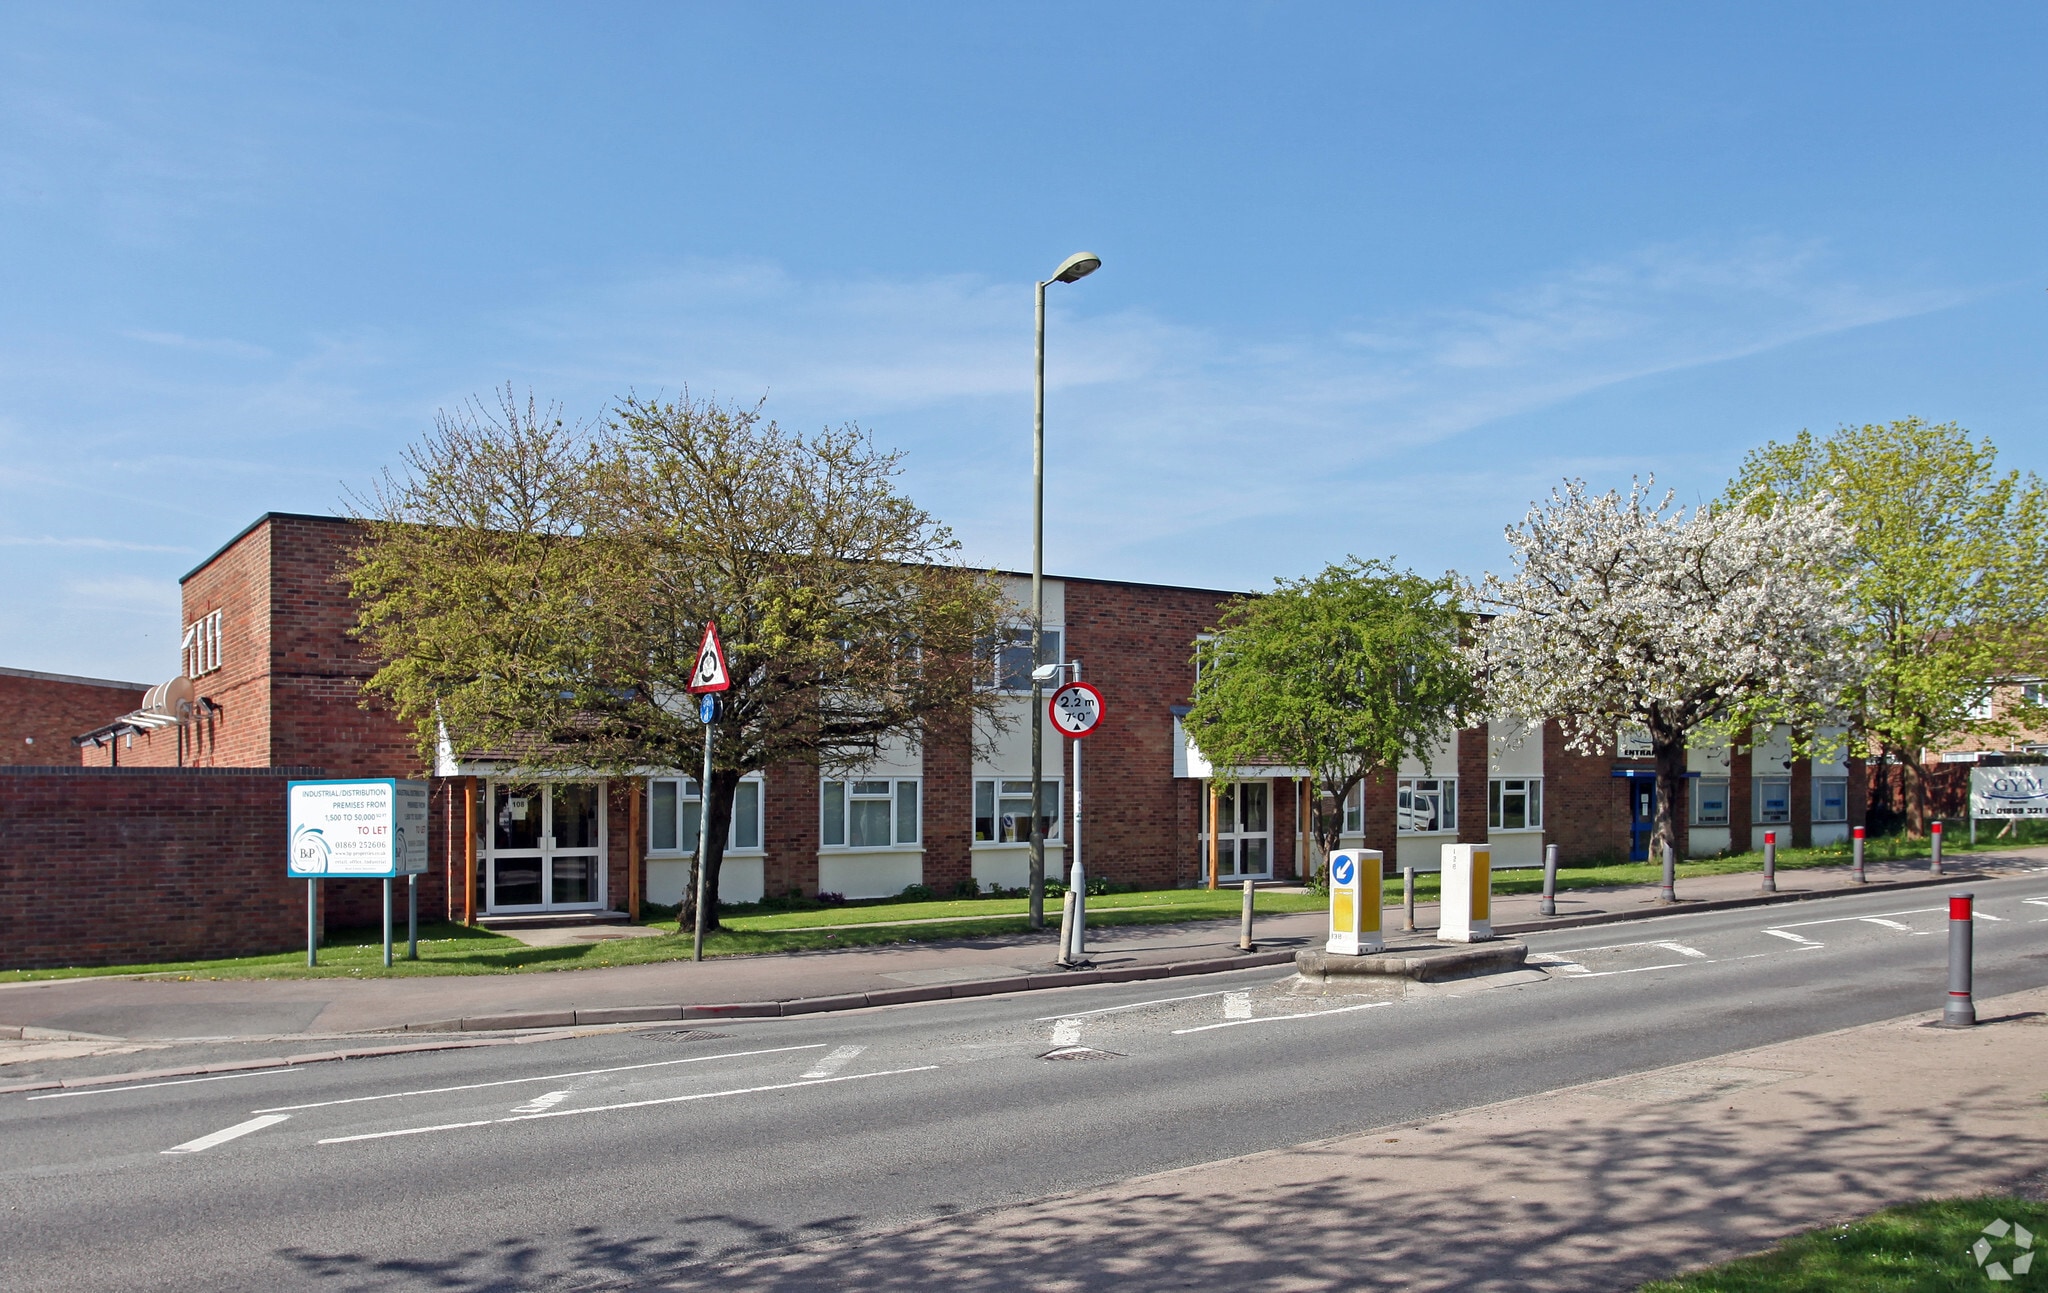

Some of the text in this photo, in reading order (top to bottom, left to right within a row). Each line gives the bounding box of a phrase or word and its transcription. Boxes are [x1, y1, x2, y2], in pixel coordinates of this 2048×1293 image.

[1060, 696, 1095, 708] 2.2 m
[1994, 778, 2044, 792] GYM
[302, 788, 387, 798] INDUSTRIAL/DISTRIBUTION
[332, 801, 387, 809] PREMISES FROM
[324, 814, 342, 822] 1,500
[354, 813, 376, 822] 50,000
[357, 826, 388, 835] TO LET
[335, 841, 387, 849] 01869 252606
